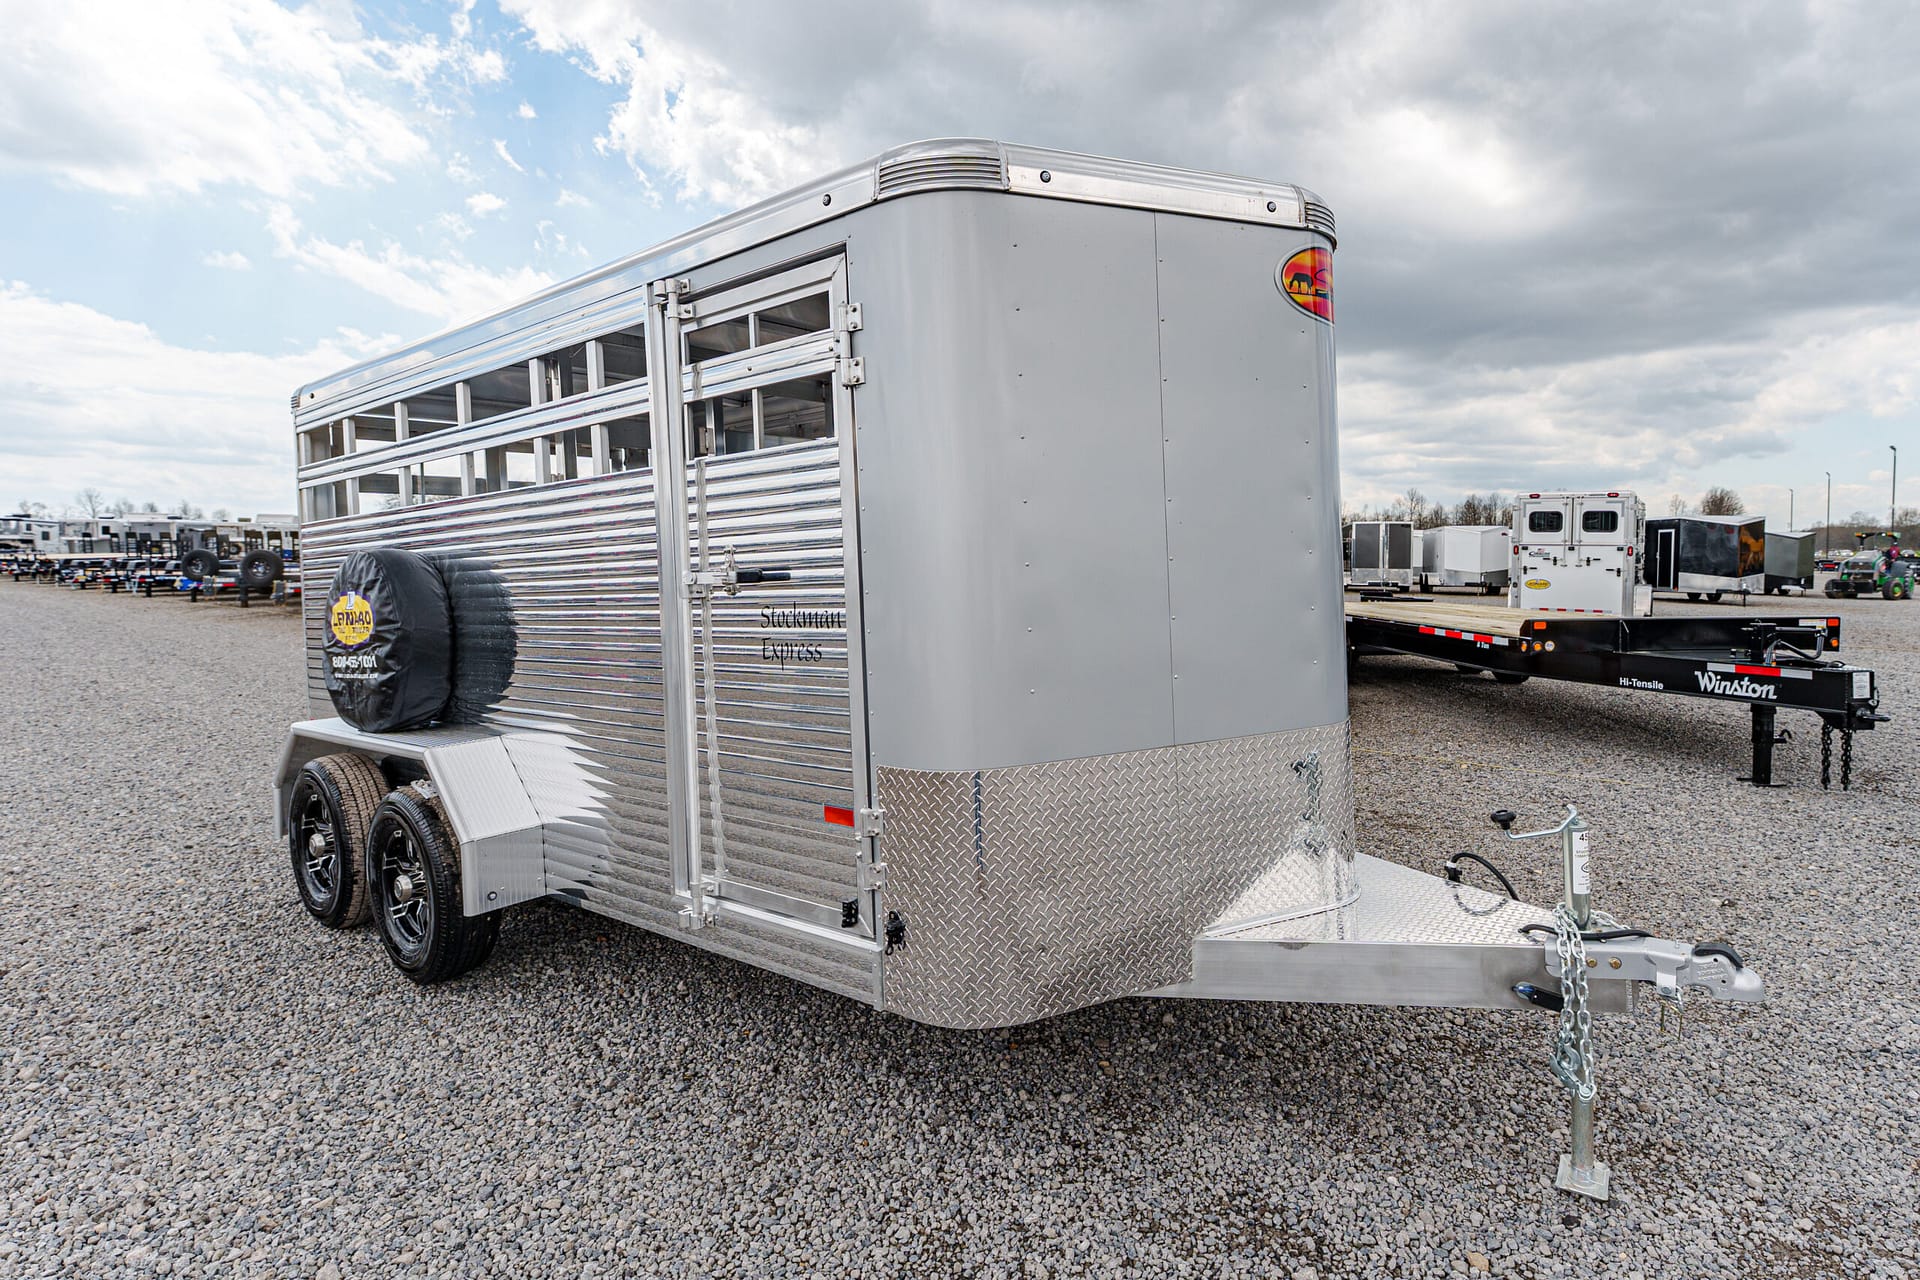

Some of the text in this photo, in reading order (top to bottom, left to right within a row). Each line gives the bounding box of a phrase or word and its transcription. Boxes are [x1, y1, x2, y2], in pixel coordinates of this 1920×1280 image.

[760, 601, 842, 629] Stockman
[761, 637, 823, 671] Express
[1619, 676, 1664, 690] Hi-Tensile
[1694, 670, 1778, 700] Winston
